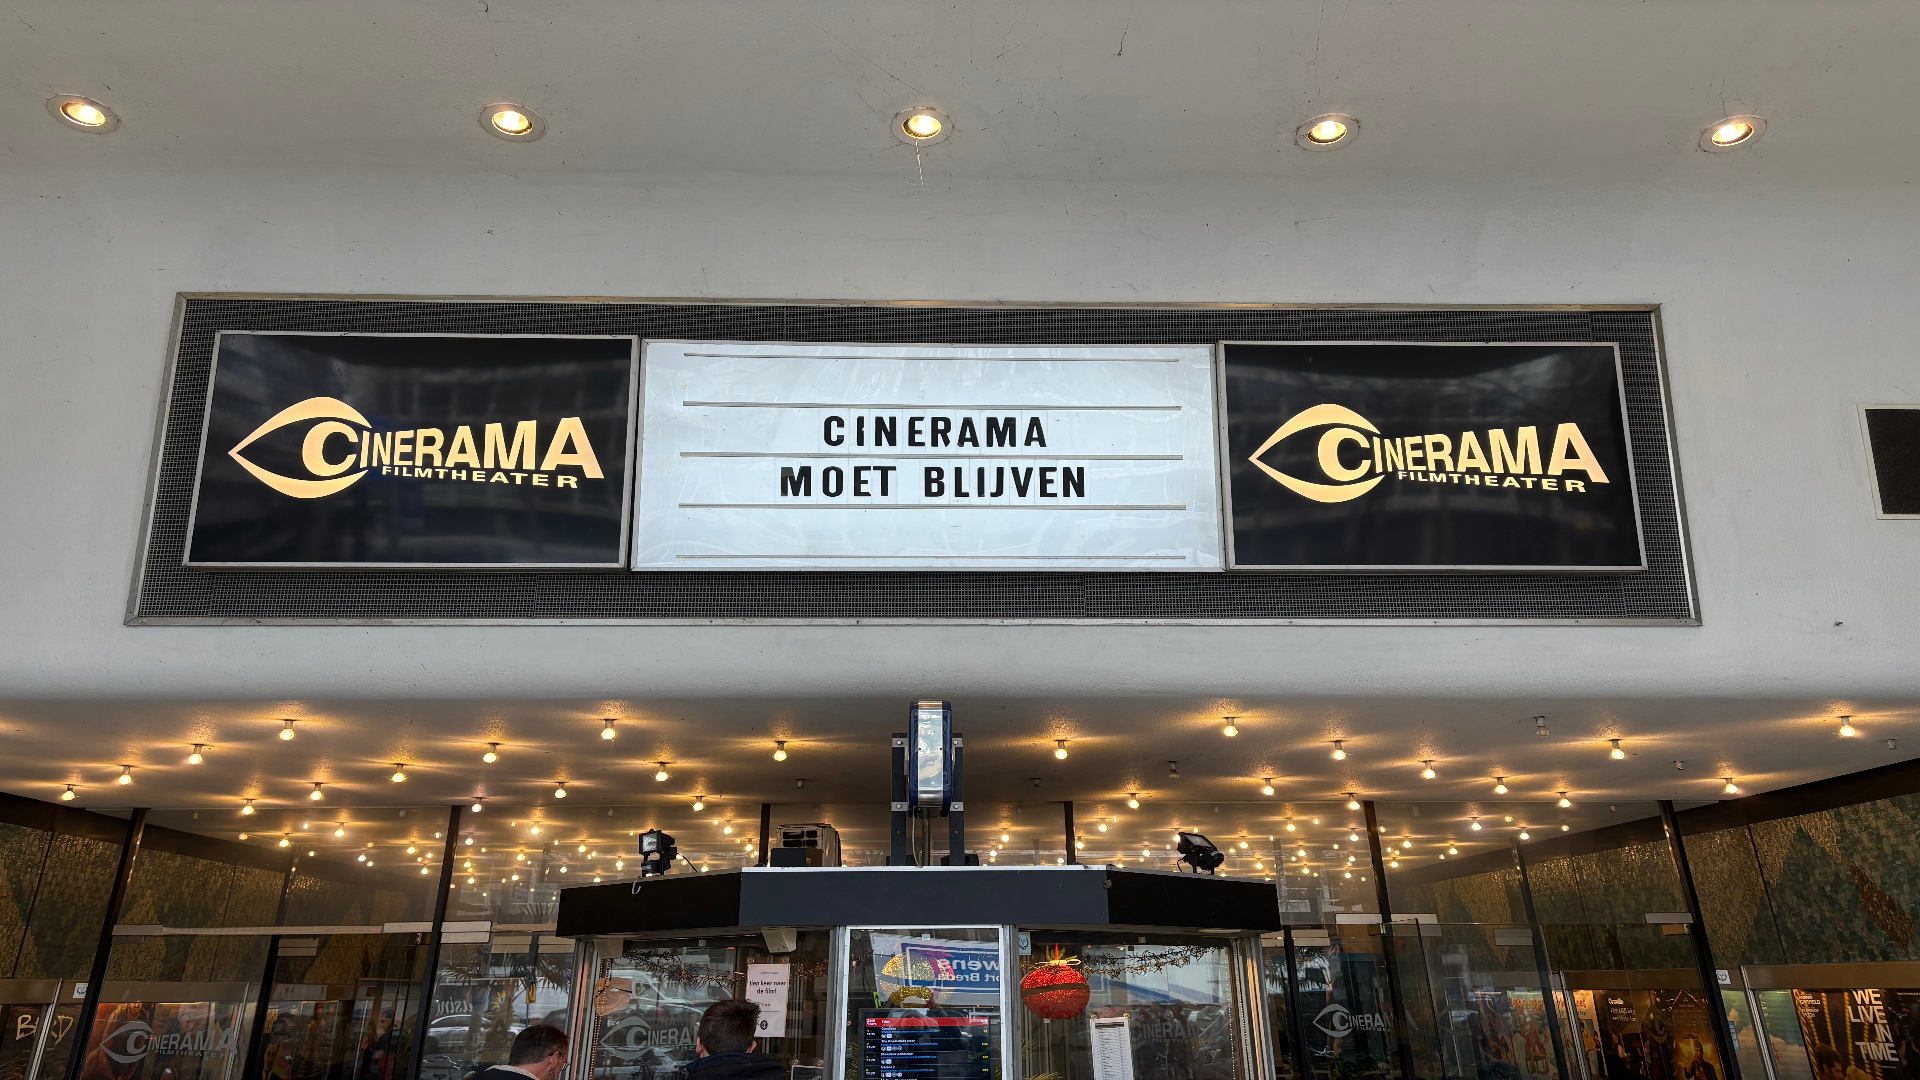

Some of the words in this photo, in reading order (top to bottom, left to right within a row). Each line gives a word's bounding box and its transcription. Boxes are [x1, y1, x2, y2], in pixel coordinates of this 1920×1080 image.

[823, 415, 1047, 447] CINERAMA
[303, 416, 604, 479] CINERAMA
[1317, 423, 1610, 484] CINERAMA
[382, 465, 579, 489] FILMTHEATER
[780, 465, 897, 497] MOET
[923, 466, 1086, 498] BLIJVEN
[1398, 471, 1587, 493] FILMTHEATER
[1850, 988, 1883, 1005] WE
[1847, 1005, 1888, 1024] LIVE
[626, 1025, 699, 1048] CINERA
[1874, 1024, 1894, 1043] IN
[1854, 1041, 1900, 1061] TIME
